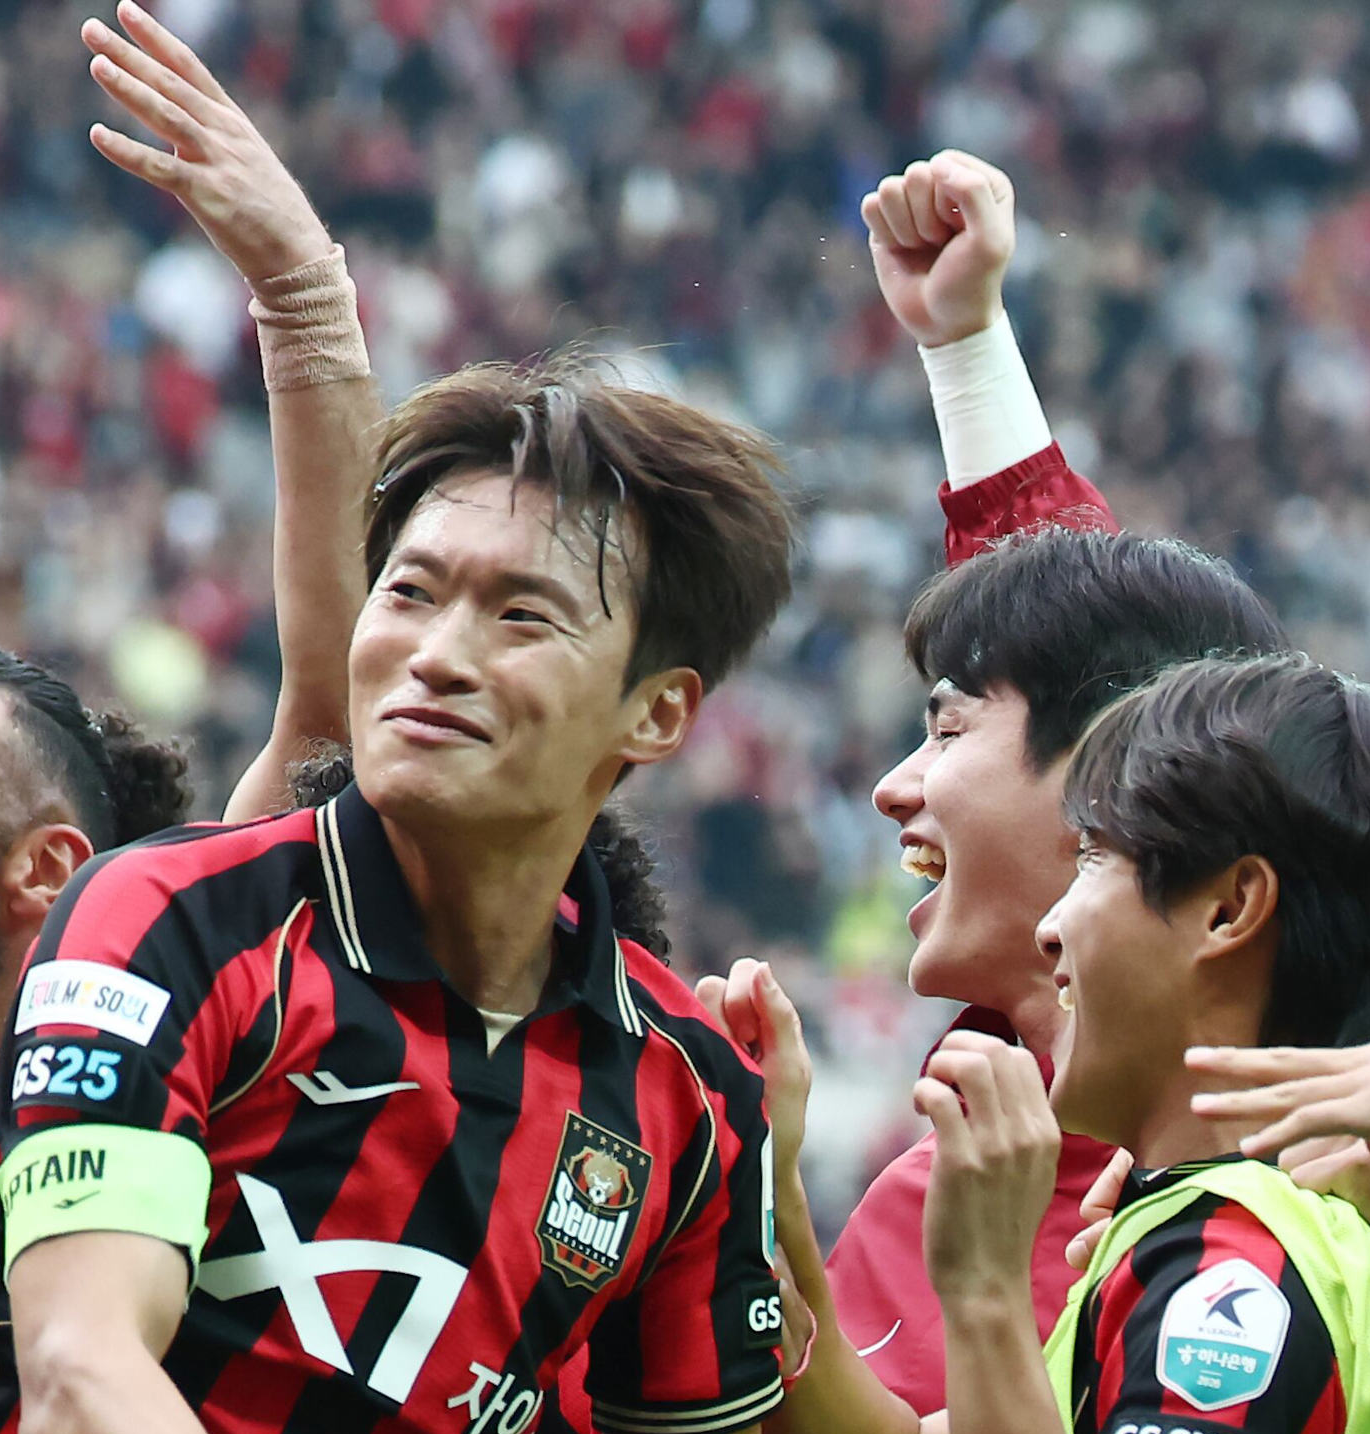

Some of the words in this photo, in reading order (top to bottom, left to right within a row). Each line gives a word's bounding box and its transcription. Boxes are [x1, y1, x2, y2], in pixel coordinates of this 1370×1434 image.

[12, 1044, 122, 1101] GS25
[545, 1170, 629, 1261] Seoul
[748, 1297, 781, 1333] GS
